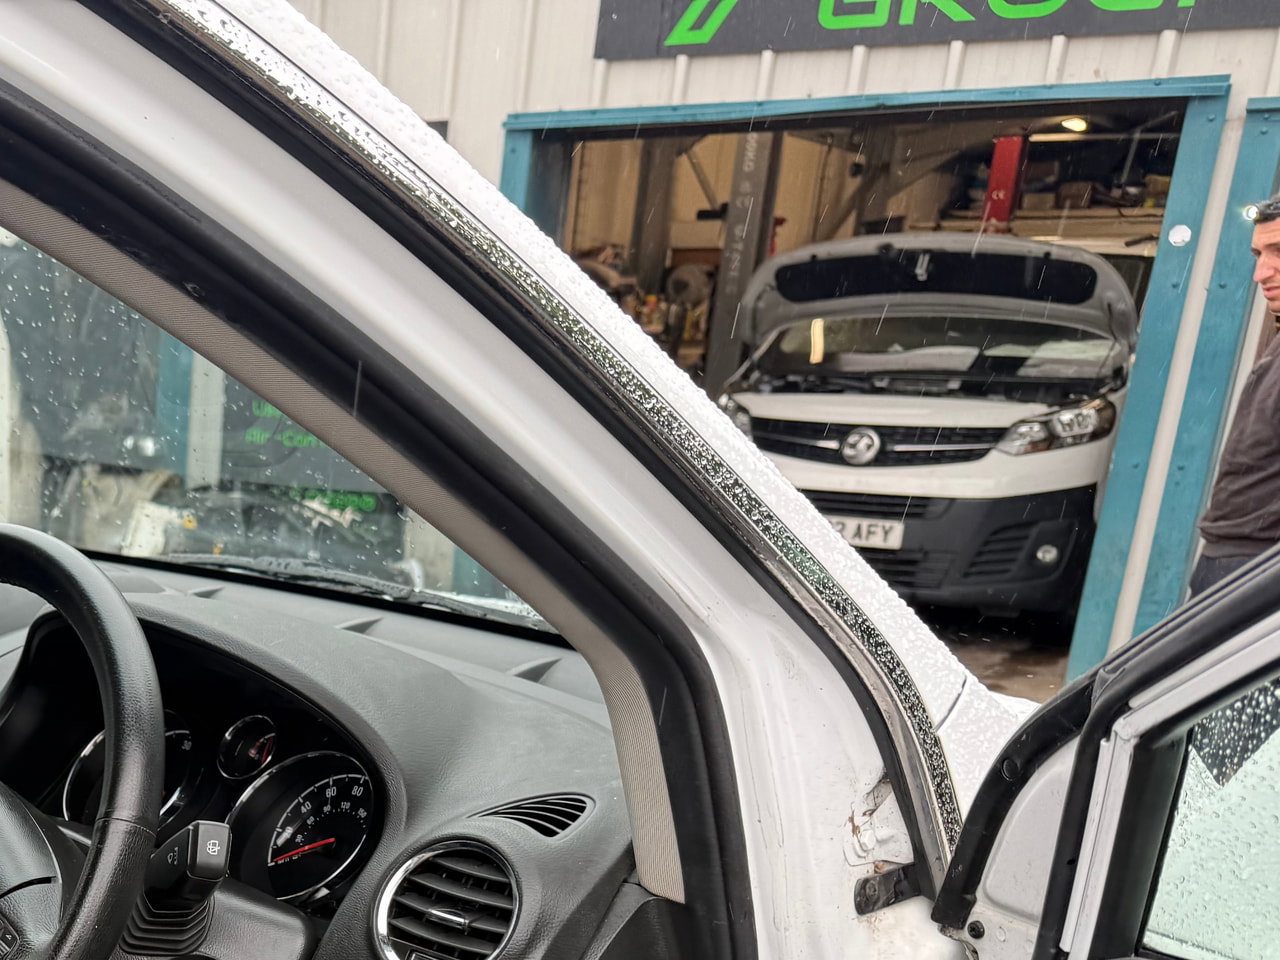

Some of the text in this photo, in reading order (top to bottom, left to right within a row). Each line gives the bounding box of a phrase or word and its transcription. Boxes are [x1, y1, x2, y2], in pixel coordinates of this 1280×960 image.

[851, 522, 894, 544] AFY
[325, 786, 337, 798] 60
[351, 785, 364, 797] 80
[300, 801, 312, 814] 40
